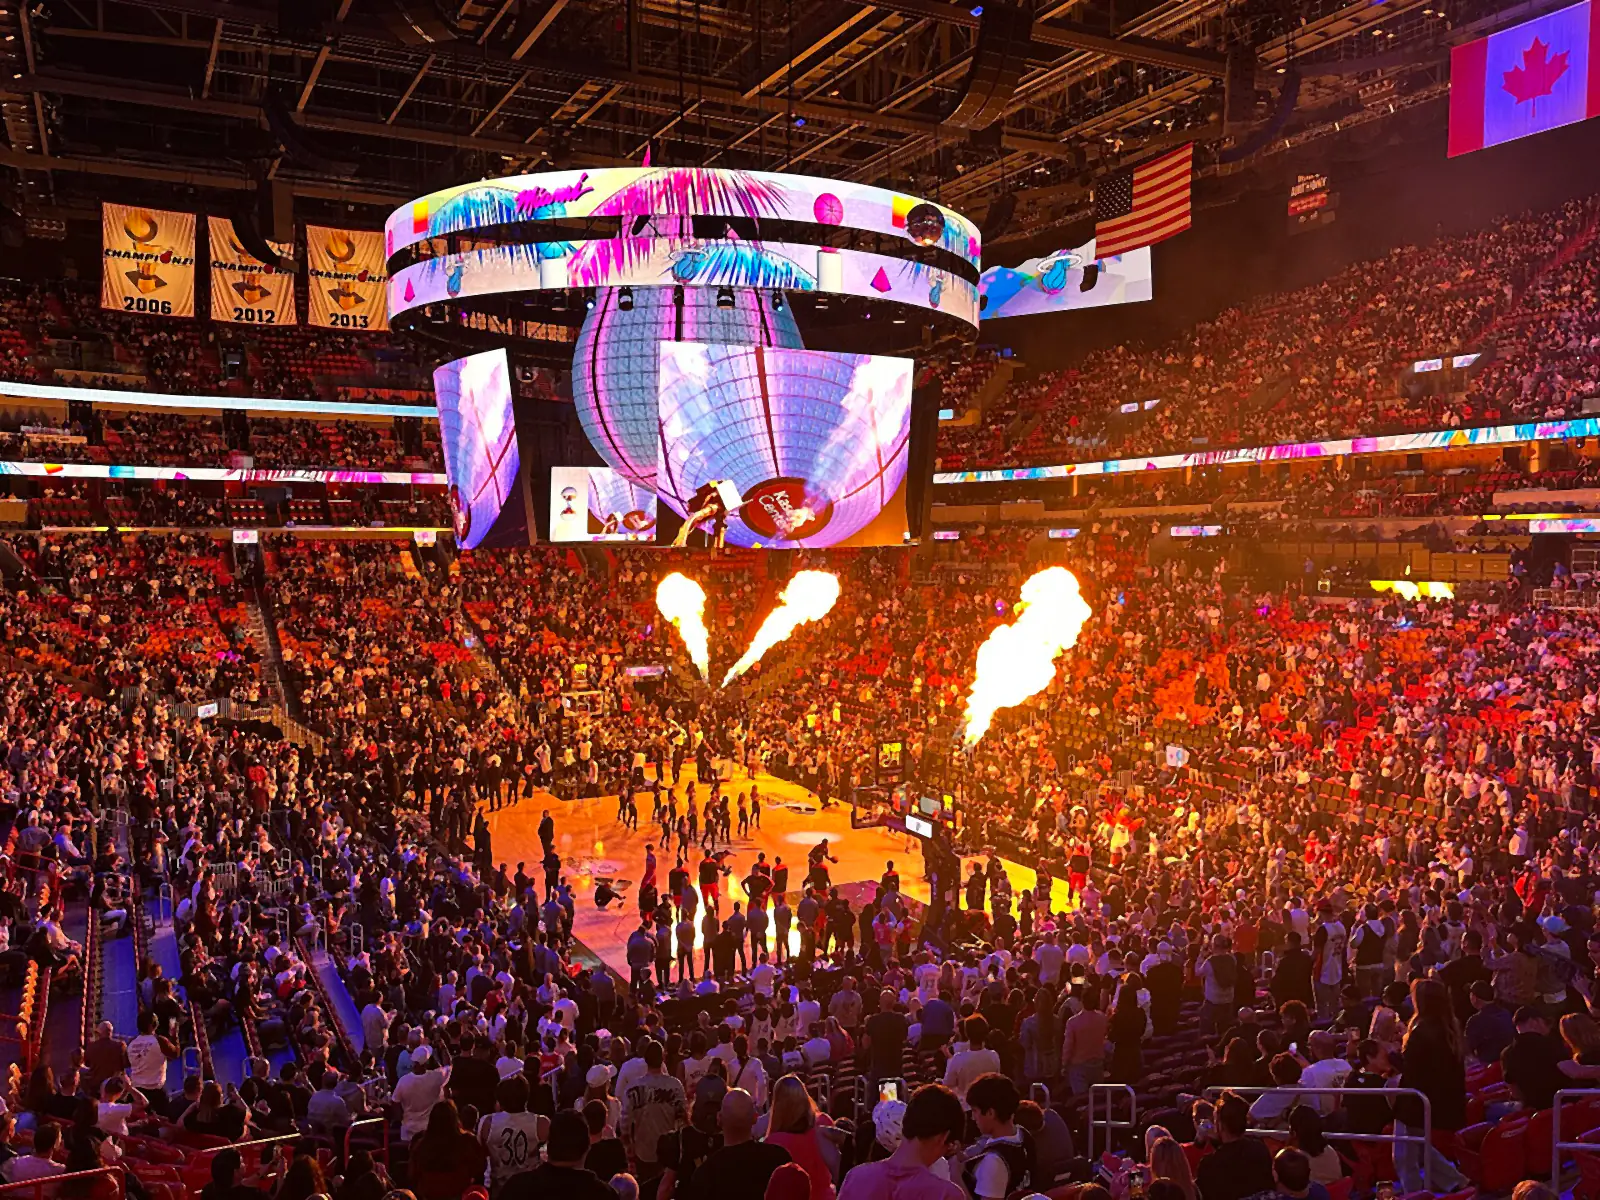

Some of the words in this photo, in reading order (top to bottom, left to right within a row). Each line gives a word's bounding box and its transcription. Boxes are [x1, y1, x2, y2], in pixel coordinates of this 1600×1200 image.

[123, 296, 172, 315] 2006
[233, 307, 276, 324] 2012
[329, 312, 369, 329] 2013
[500, 1127, 528, 1166] 30
